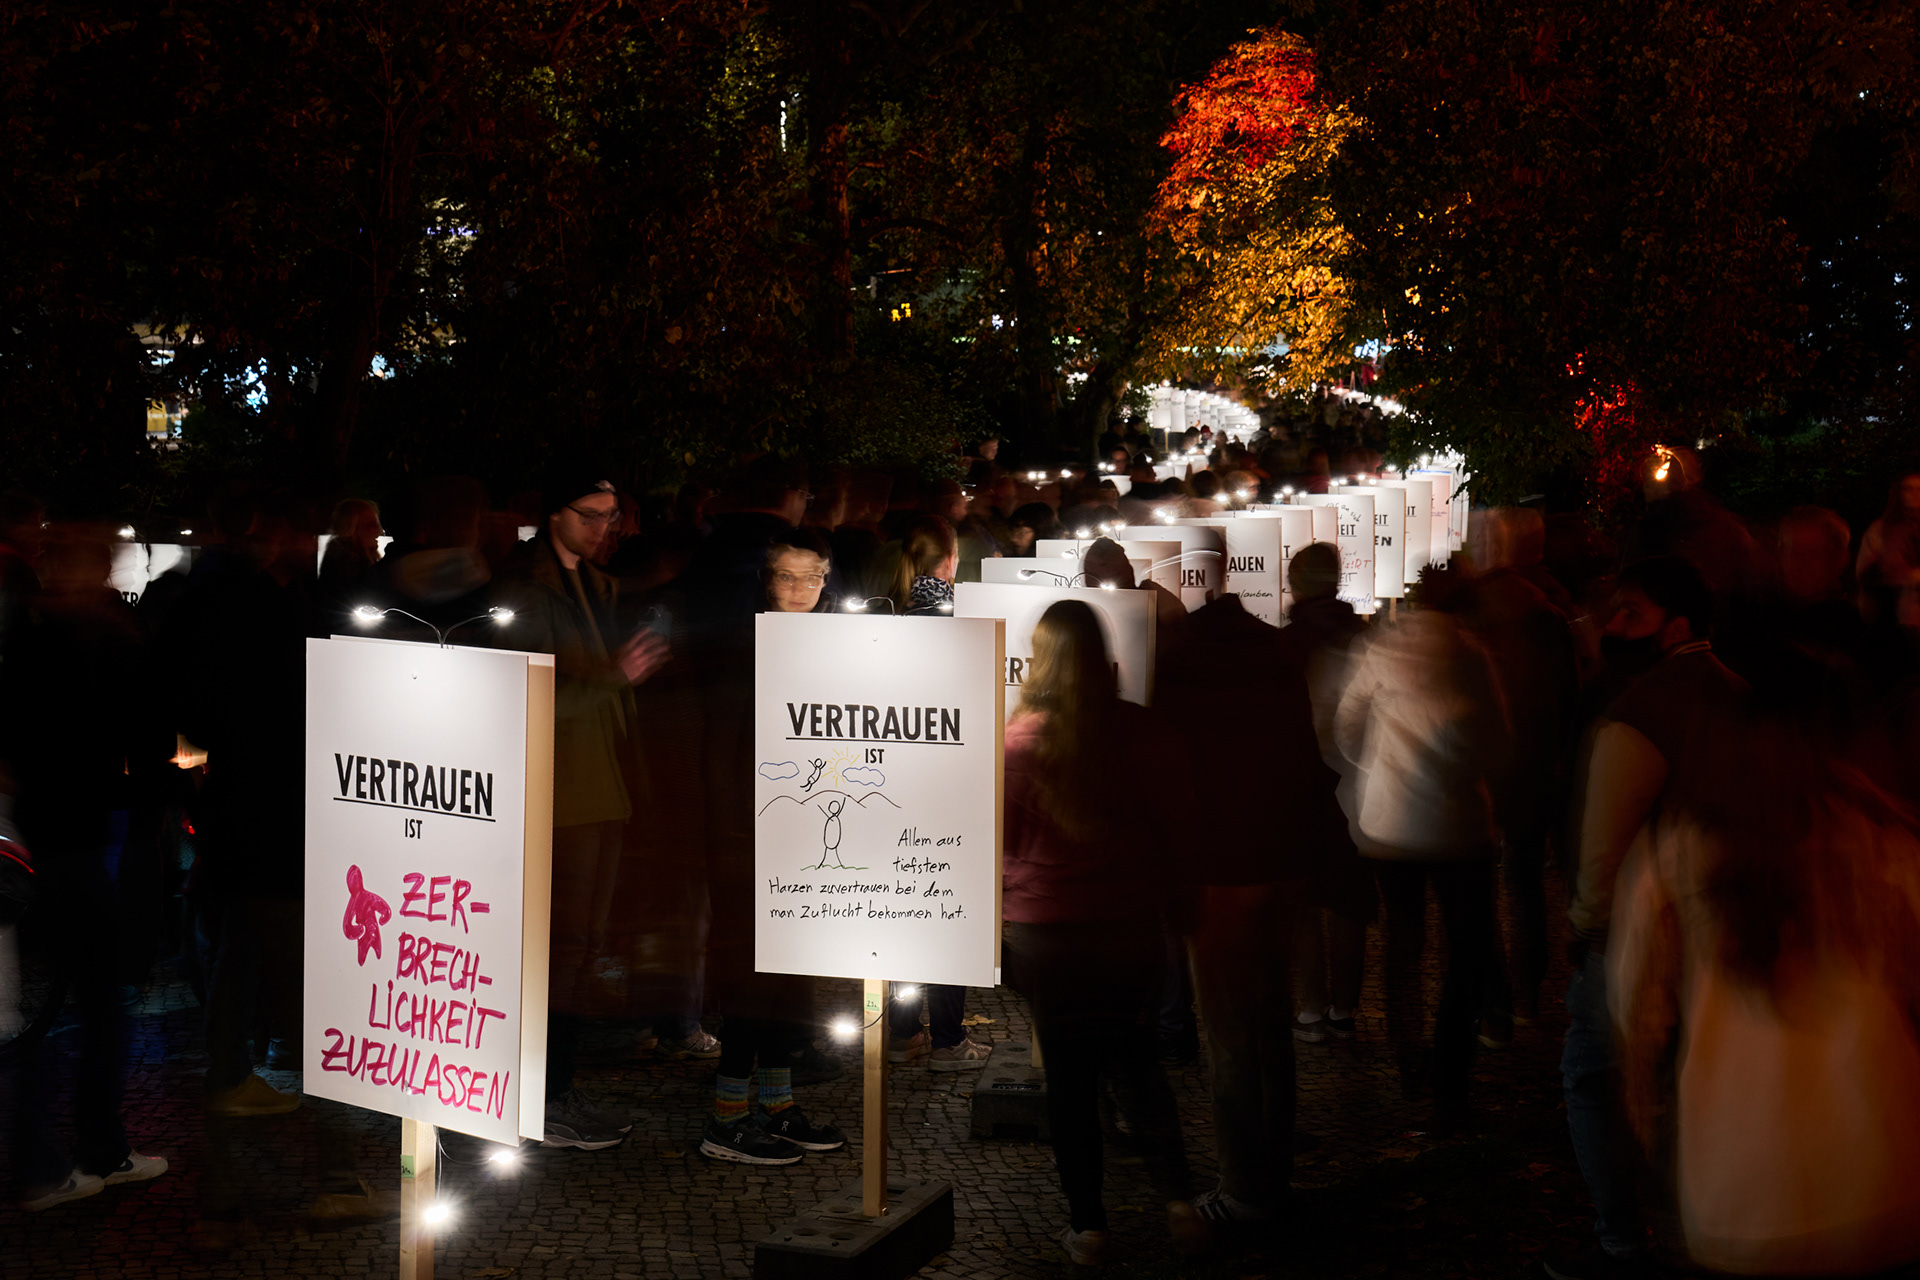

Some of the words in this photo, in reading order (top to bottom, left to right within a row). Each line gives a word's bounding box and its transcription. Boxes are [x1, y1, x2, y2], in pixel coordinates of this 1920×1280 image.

[1374, 514, 1388, 525] EIT
[1407, 506, 1416, 516] IT
[1338, 524, 1356, 536] EIT
[1374, 535, 1393, 547] EN
[1228, 556, 1265, 571] AUEN
[786, 702, 961, 742] VERTRAUEN
[865, 748, 885, 764] IST
[334, 753, 493, 817] VERTRAUEN
[405, 818, 423, 839] IST
[897, 827, 932, 847] Allem
[936, 834, 962, 847] aus
[893, 856, 951, 874] tiefstem
[895, 880, 917, 895] bei
[923, 880, 954, 898] dem
[399, 872, 490, 934] ZER-
[770, 907, 795, 919] man
[868, 900, 932, 919] bekommen
[941, 903, 967, 920] hat.
[397, 931, 493, 995] BRECH-
[321, 1028, 510, 1120] ZUZULASSEN
